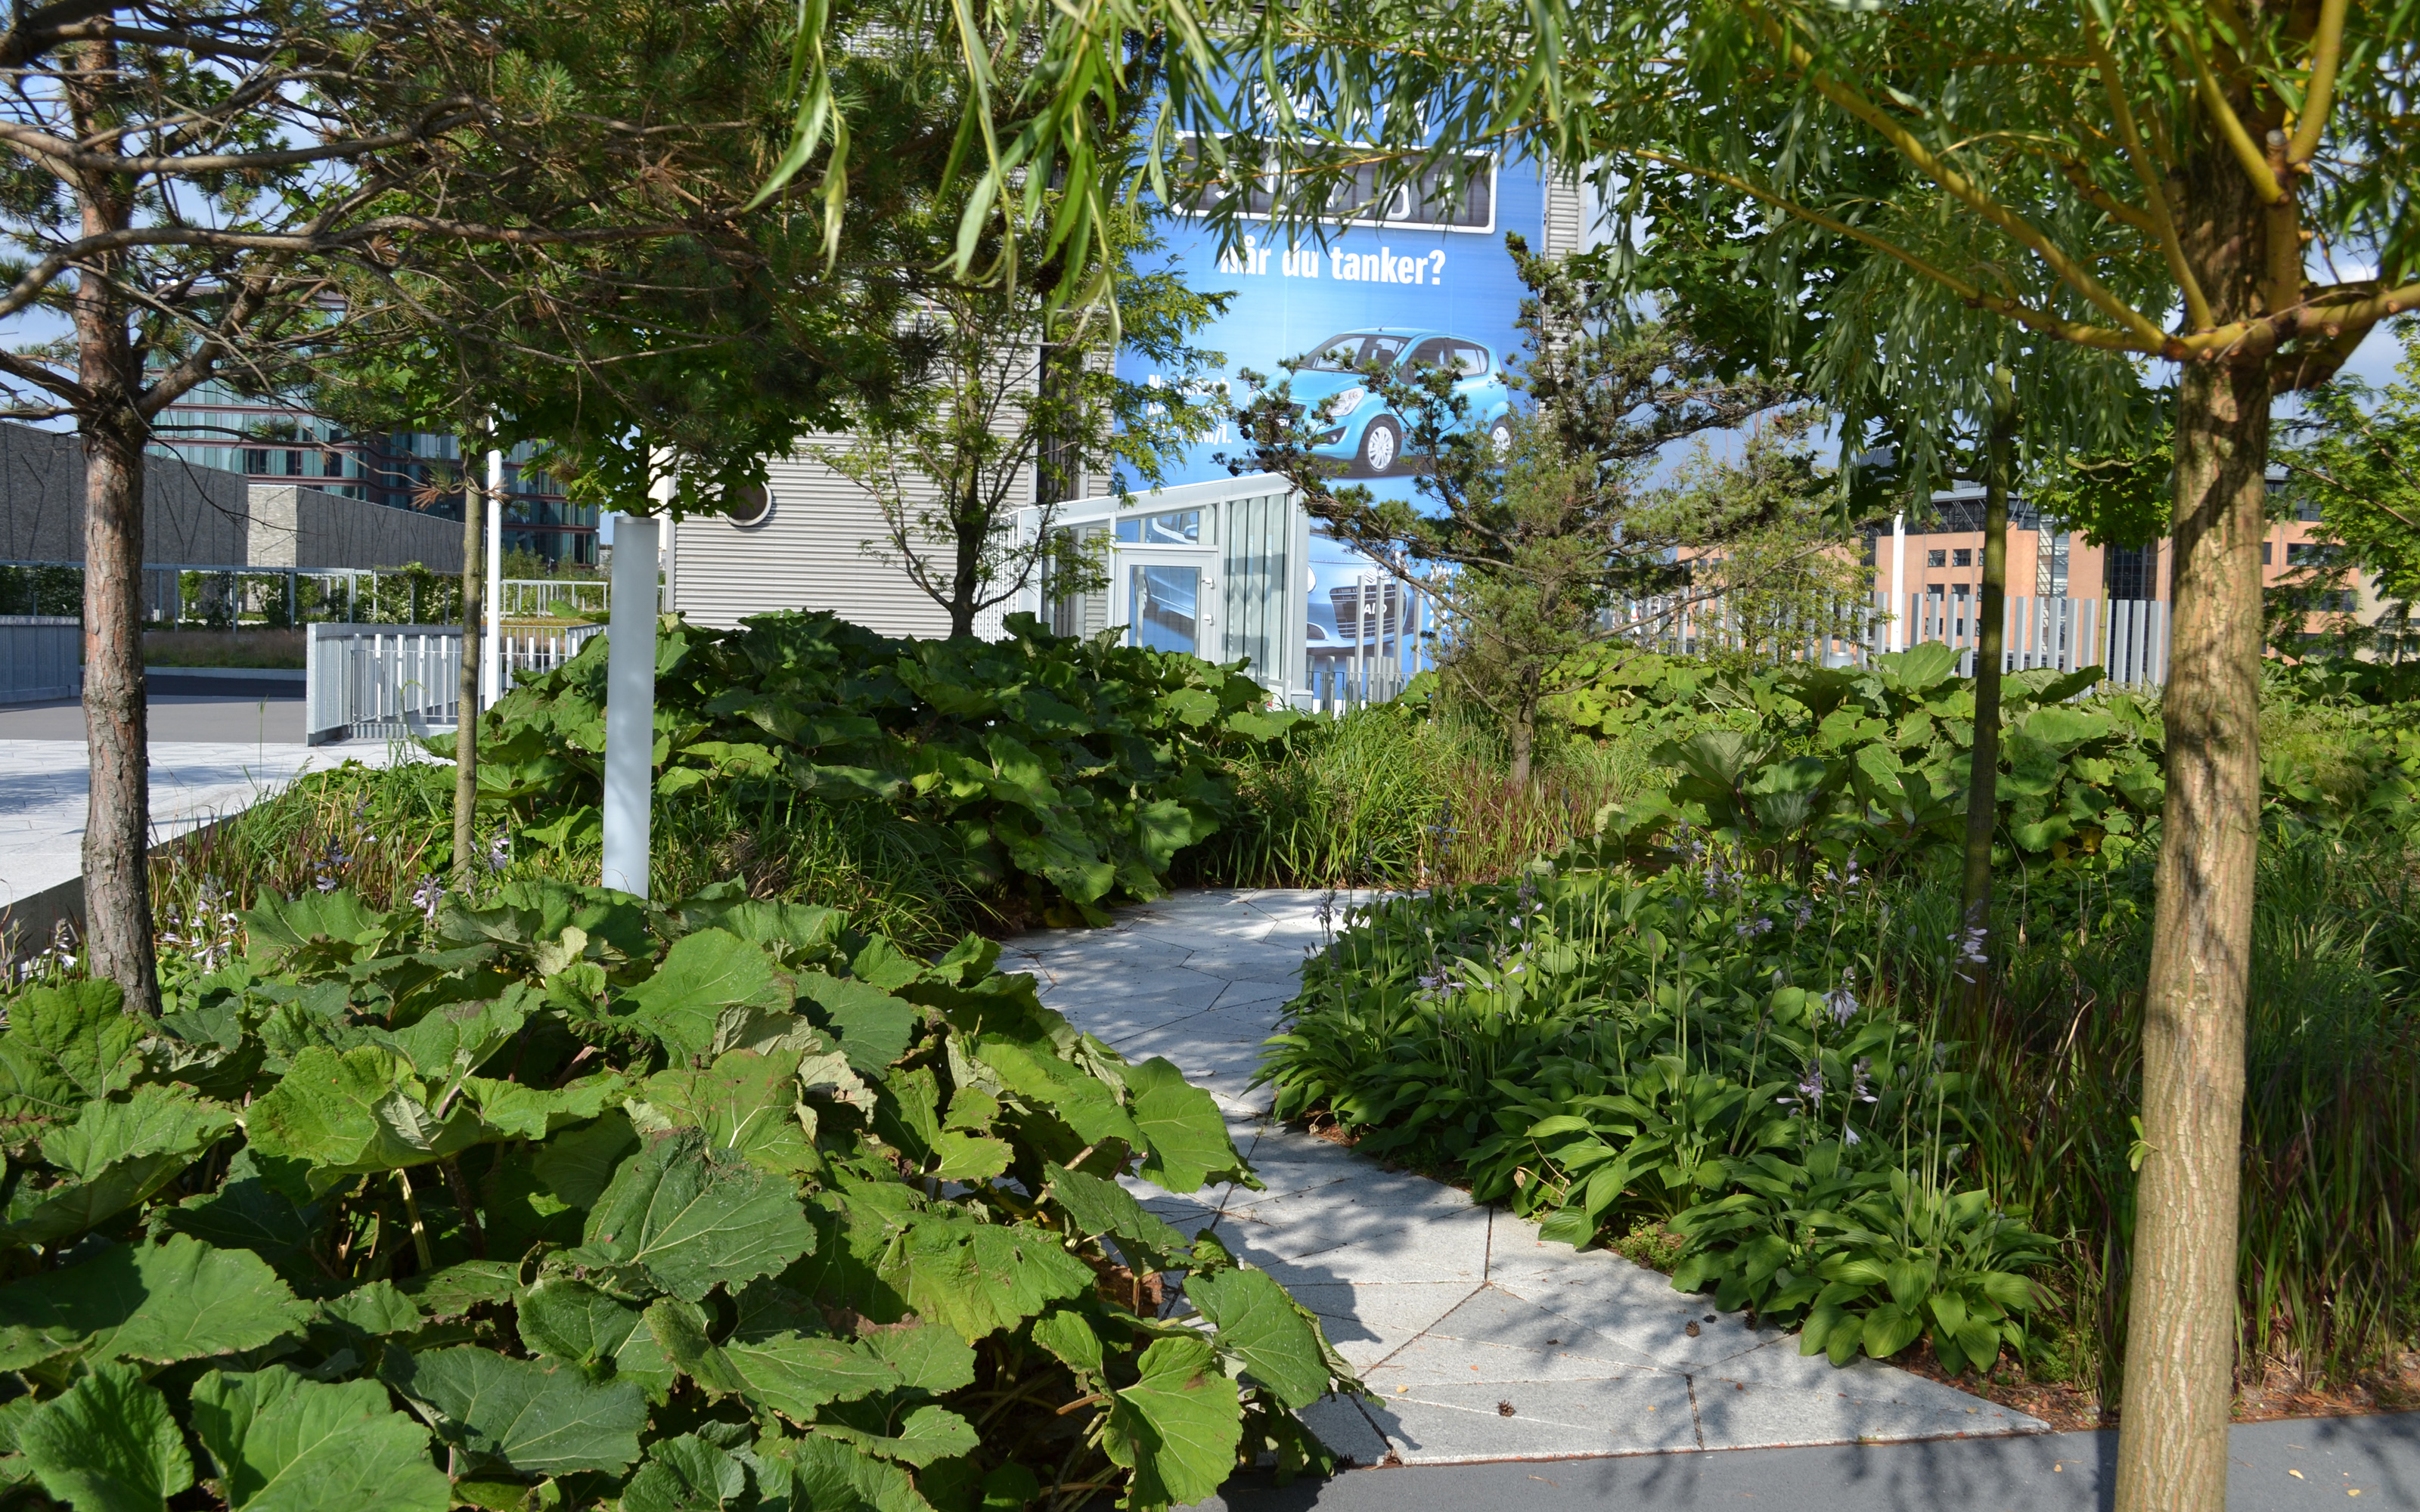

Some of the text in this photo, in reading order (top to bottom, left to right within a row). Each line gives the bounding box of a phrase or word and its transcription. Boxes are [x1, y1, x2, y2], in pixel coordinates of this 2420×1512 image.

[1220, 234, 1446, 285] når du tanker?
[1364, 603, 1388, 615] Alo
